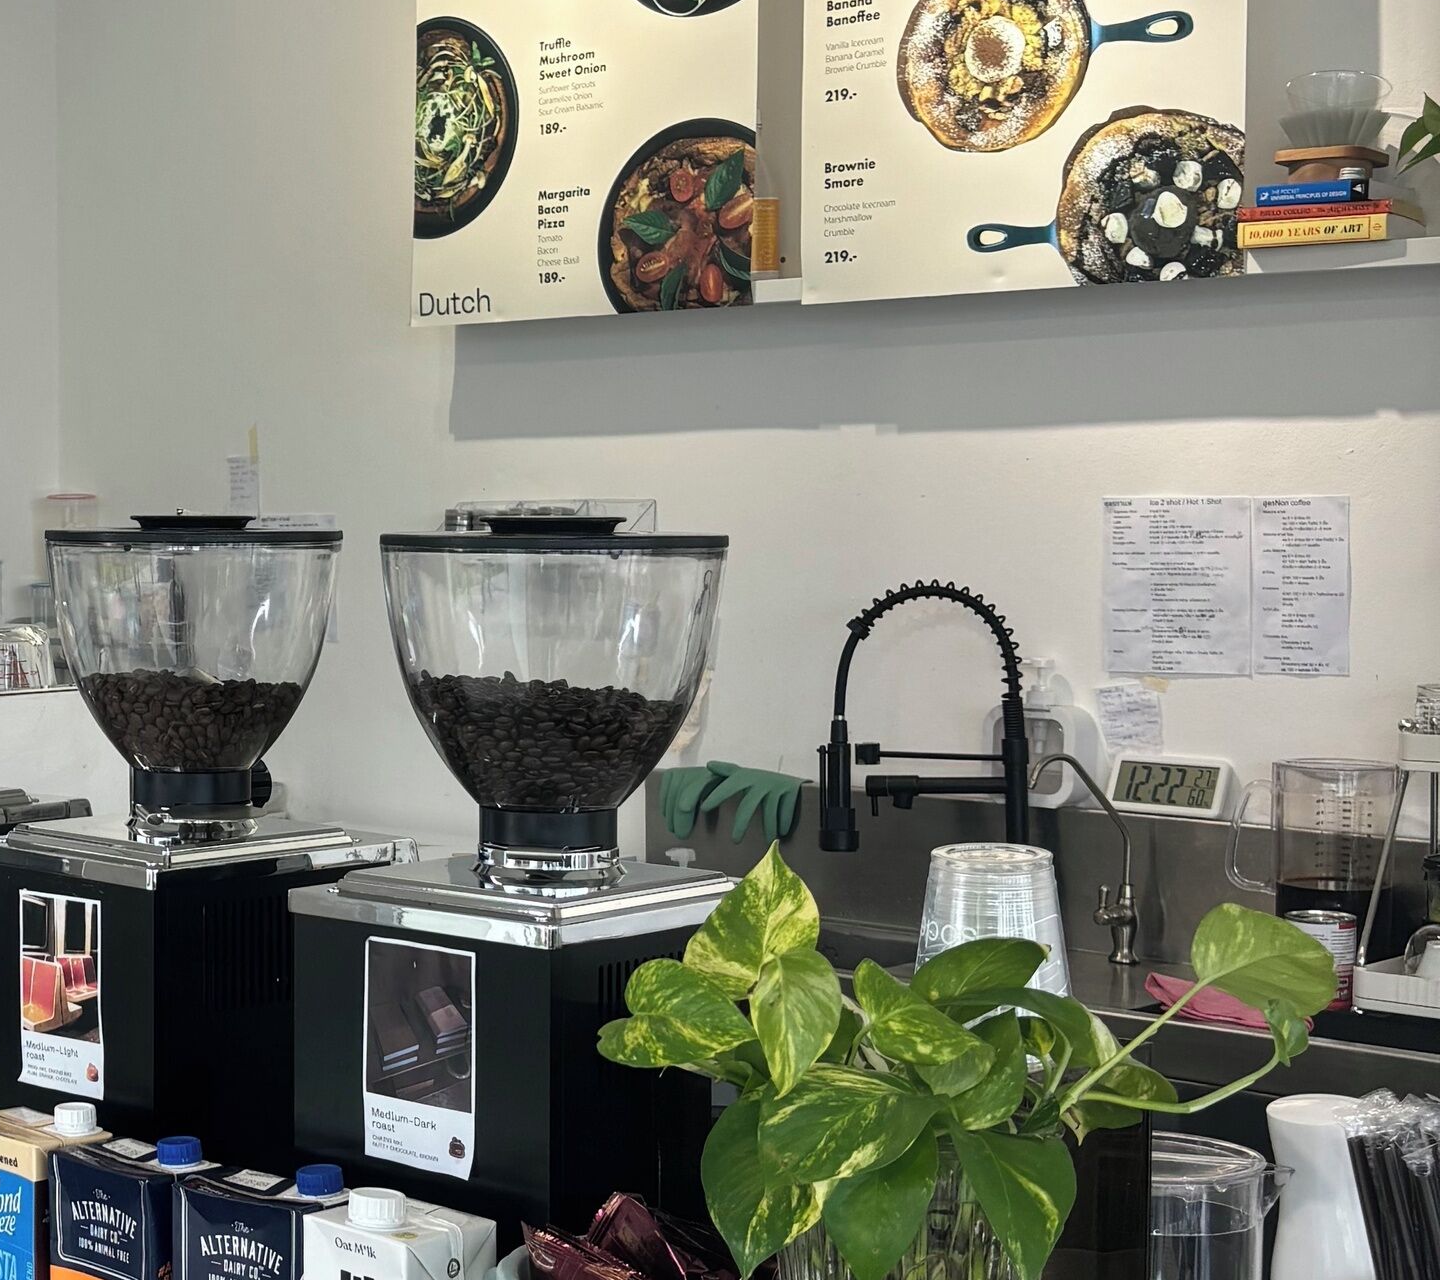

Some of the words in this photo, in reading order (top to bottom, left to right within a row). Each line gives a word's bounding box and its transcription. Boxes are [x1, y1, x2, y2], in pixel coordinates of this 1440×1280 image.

[826, 10, 881, 28] Banoffee
[540, 37, 571, 51] Truffle
[539, 51, 595, 66] Mushroom
[825, 53, 853, 63] Banana
[539, 68, 571, 81] Sweet
[574, 63, 607, 75] Onion
[825, 65, 854, 75] Brownie
[856, 61, 887, 71] Crumble
[825, 88, 857, 103] 219.-
[540, 122, 567, 135] 189.-
[824, 158, 876, 174] Brownie
[824, 177, 864, 189] Smore
[538, 187, 591, 202] Margarita
[538, 204, 569, 215] Bacon
[824, 202, 861, 213] Chocolate
[538, 219, 565, 230] Pizza
[824, 214, 873, 225] Marshmallow
[824, 227, 855, 238] Crumble
[1248, 228, 1284, 240] 10,000
[1287, 225, 1321, 237] YEARS
[1323, 224, 1339, 234] OF
[1340, 223, 1363, 234] ART
[538, 234, 563, 244] Tomato
[537, 246, 558, 255] Bacon
[824, 250, 857, 264] 219.-
[537, 258, 562, 267] Cheese
[563, 256, 581, 265] Basil
[538, 271, 566, 284] 189.-
[419, 287, 491, 317] Dutch
[1166, 498, 1181, 506] shot
[1186, 498, 1199, 506] Hot
[26, 1040, 78, 1058] Medium-Light
[26, 1051, 45, 1061] roast
[371, 1107, 437, 1131] Medium-Dark
[372, 1120, 396, 1133] roast
[71, 1200, 138, 1240] ALTERNATIVE
[89, 1223, 108, 1238] DAIRY
[78, 1236, 94, 1250] 100%
[95, 1240, 115, 1260] ANIMAL
[116, 1248, 130, 1264] FREE
[335, 1236, 352, 1253] Oat
[200, 1234, 283, 1275] ALTERNATIVE
[223, 1259, 246, 1276] DAIRY
